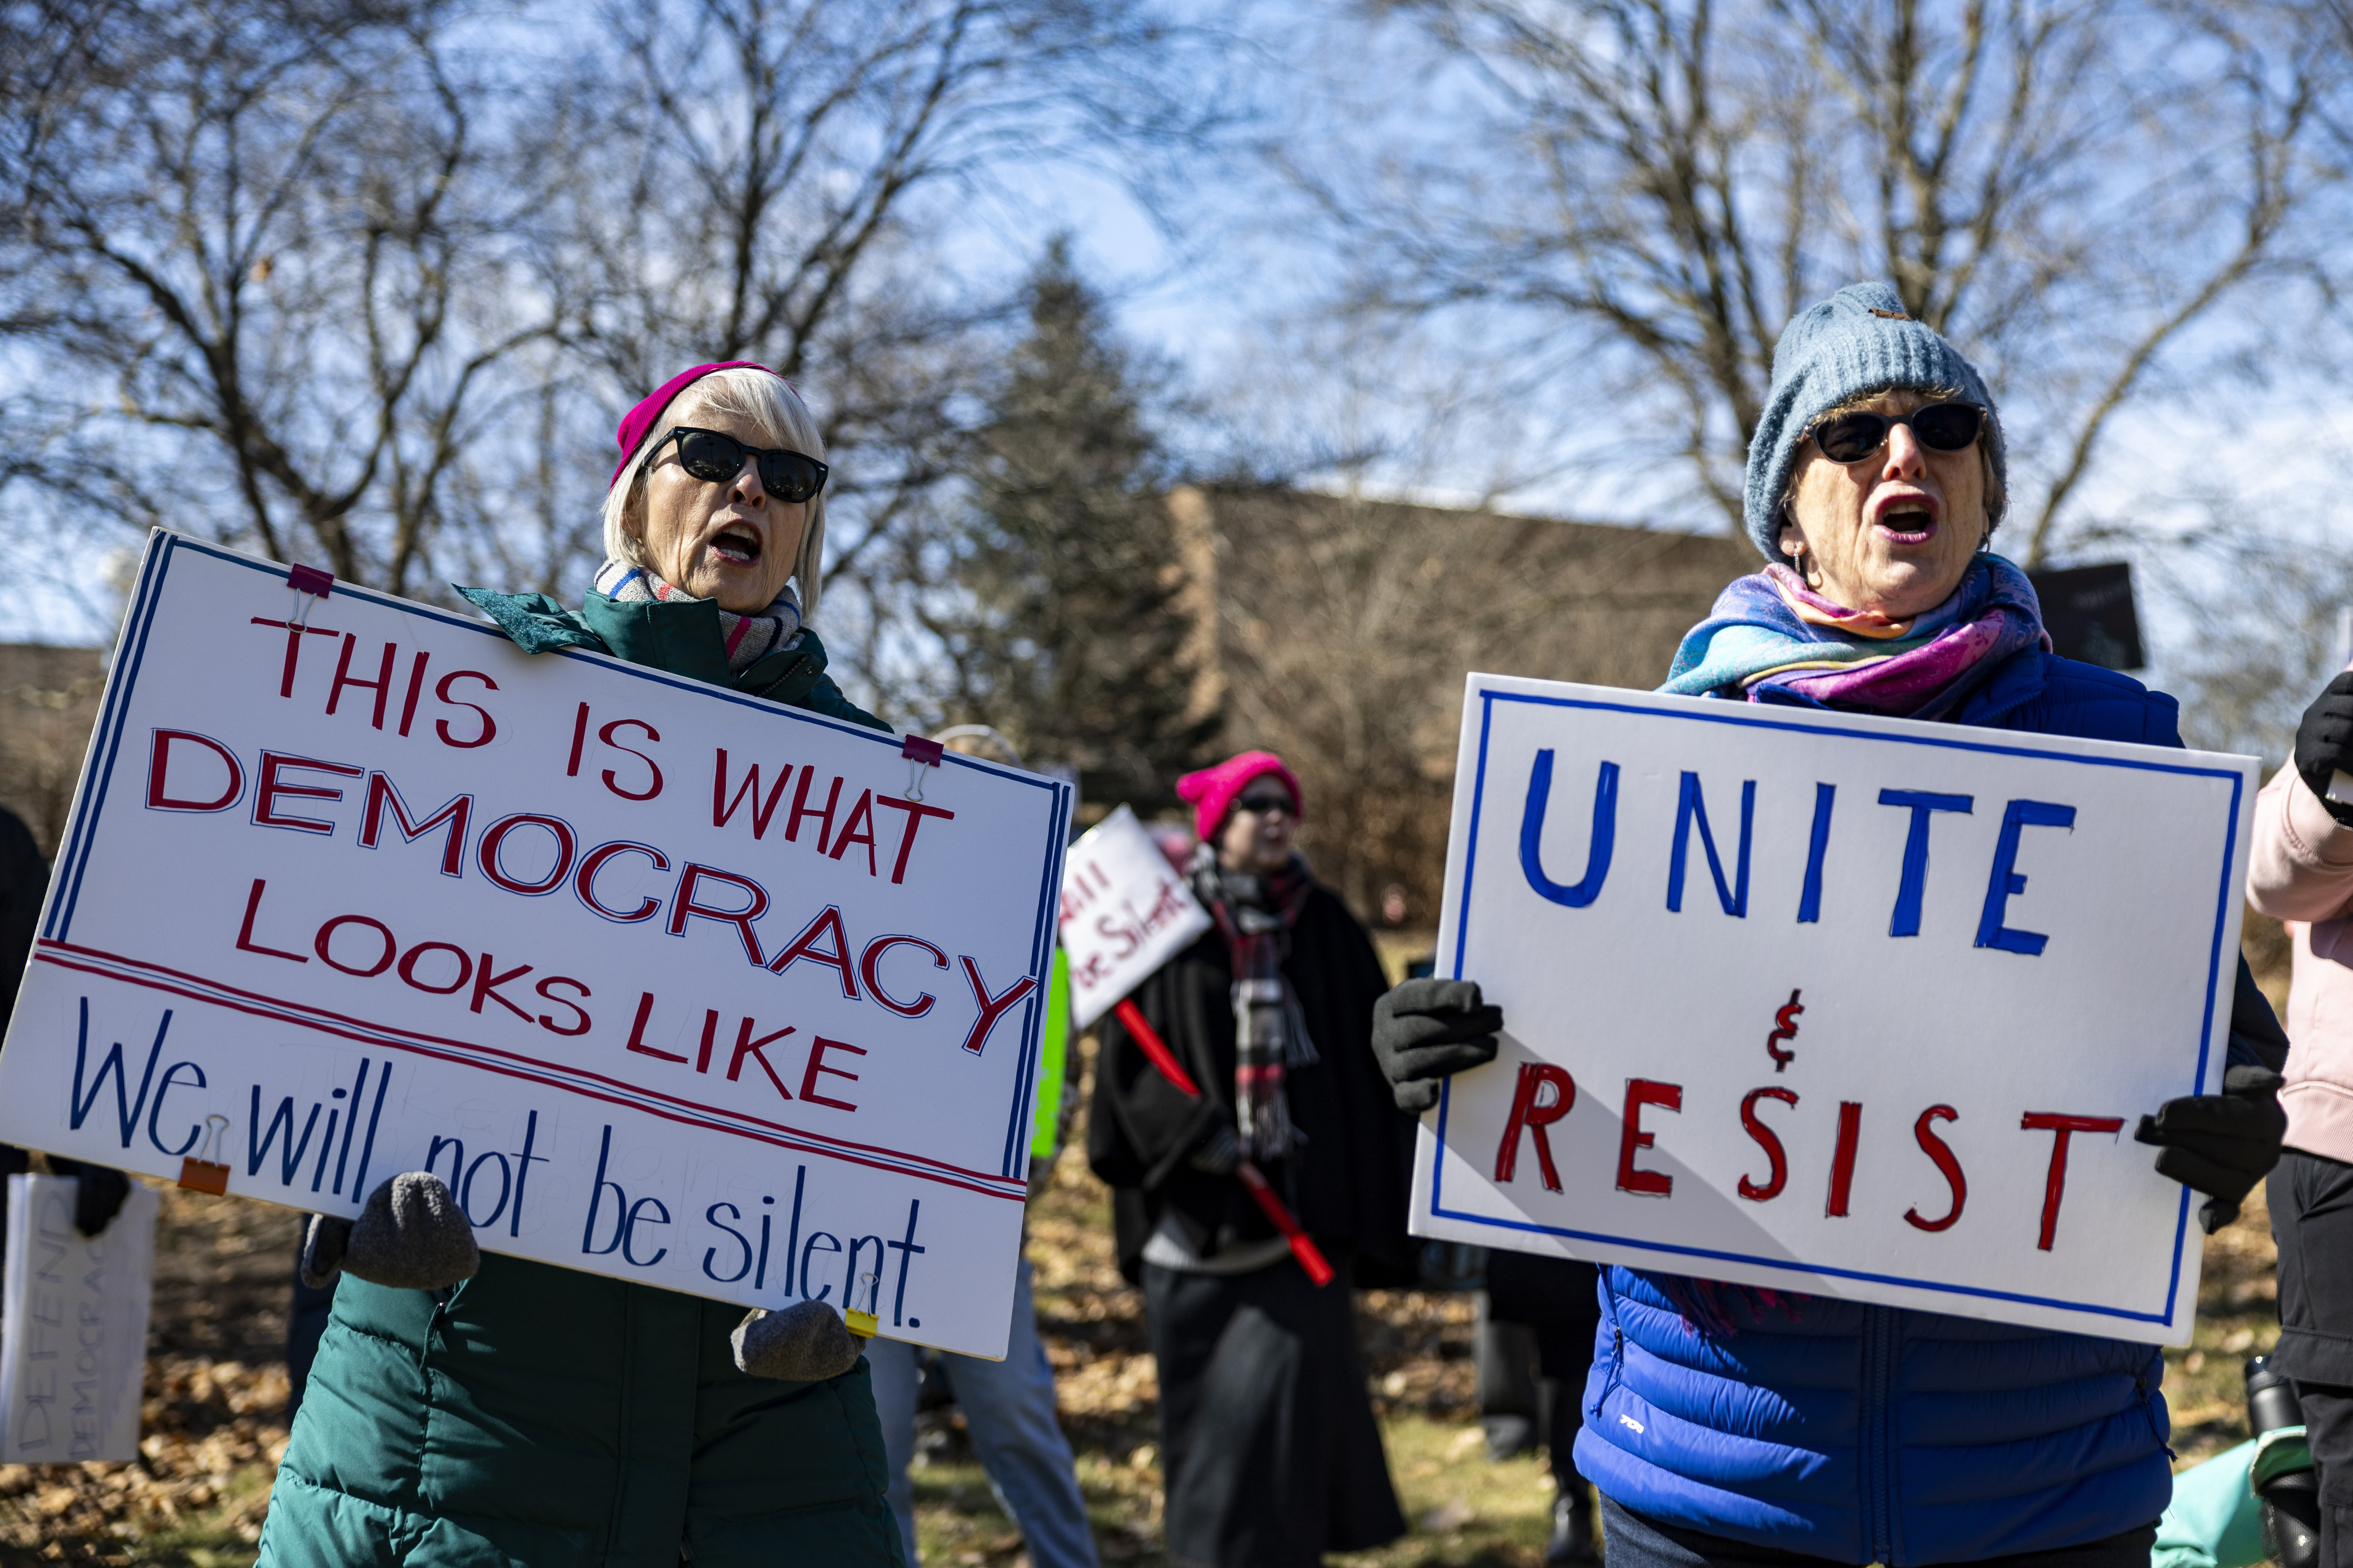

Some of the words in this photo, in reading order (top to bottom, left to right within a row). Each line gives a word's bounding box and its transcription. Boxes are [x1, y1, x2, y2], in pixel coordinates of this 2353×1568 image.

[251, 617, 500, 749] THIS
[567, 702, 663, 801] IS
[713, 748, 955, 885] WHAT
[1519, 749, 2076, 956] UNITE
[145, 727, 1039, 1056] DEMOCRACY
[236, 879, 592, 1036] LOOKS
[626, 992, 868, 1112] LIKE
[1766, 988, 1804, 1072] &
[70, 996, 207, 1155] We
[248, 1057, 392, 1204] will
[424, 1109, 550, 1238] not
[581, 1124, 671, 1267] be
[703, 1165, 925, 1328] silent.
[1495, 1061, 2127, 1252] RESIST
[18, 1190, 73, 1453] DEFEND
[68, 1238, 106, 1461] DEMOCRAC
